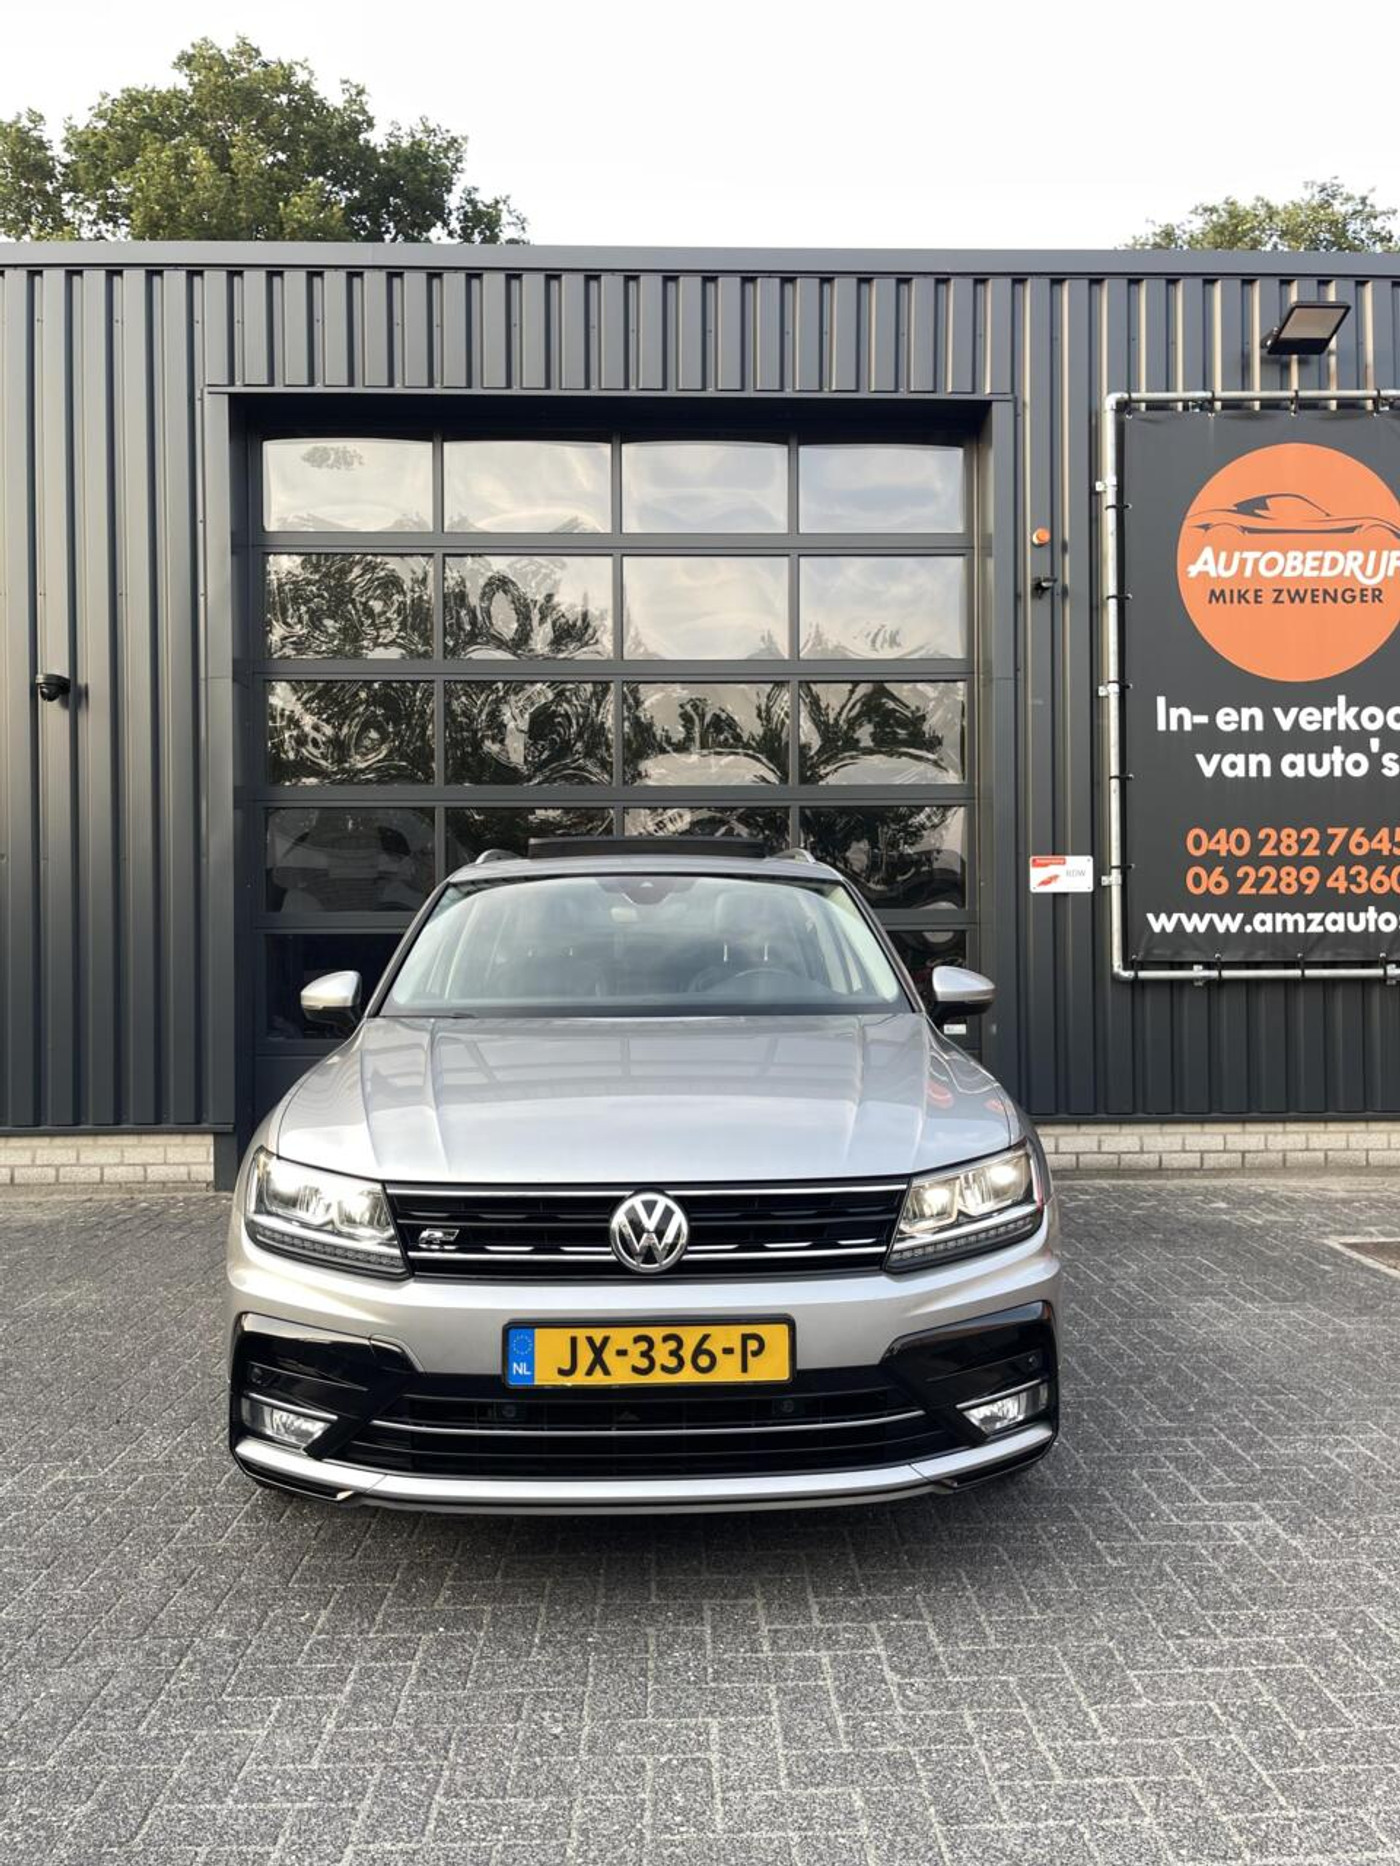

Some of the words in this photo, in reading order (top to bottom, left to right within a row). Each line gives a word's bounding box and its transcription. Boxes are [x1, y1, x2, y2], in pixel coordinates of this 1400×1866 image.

[1187, 546, 1400, 585] AUTOBEDRIJF
[1208, 588, 1263, 604] MIKE
[1272, 587, 1384, 604] ZWENGER
[1156, 695, 1209, 731] In-
[1215, 706, 1264, 731] en
[1273, 694, 1400, 731] verkoo
[1195, 753, 1271, 777] van
[1280, 737, 1400, 777] auto's
[1186, 827, 1251, 857] 040
[1258, 827, 1321, 857] 282
[1186, 865, 1230, 895] 06
[1236, 865, 1321, 895] 2289
[1146, 906, 1400, 933] www.amzauto
[512, 1362, 531, 1375] NL
[557, 1333, 766, 1377] JX-336-P
